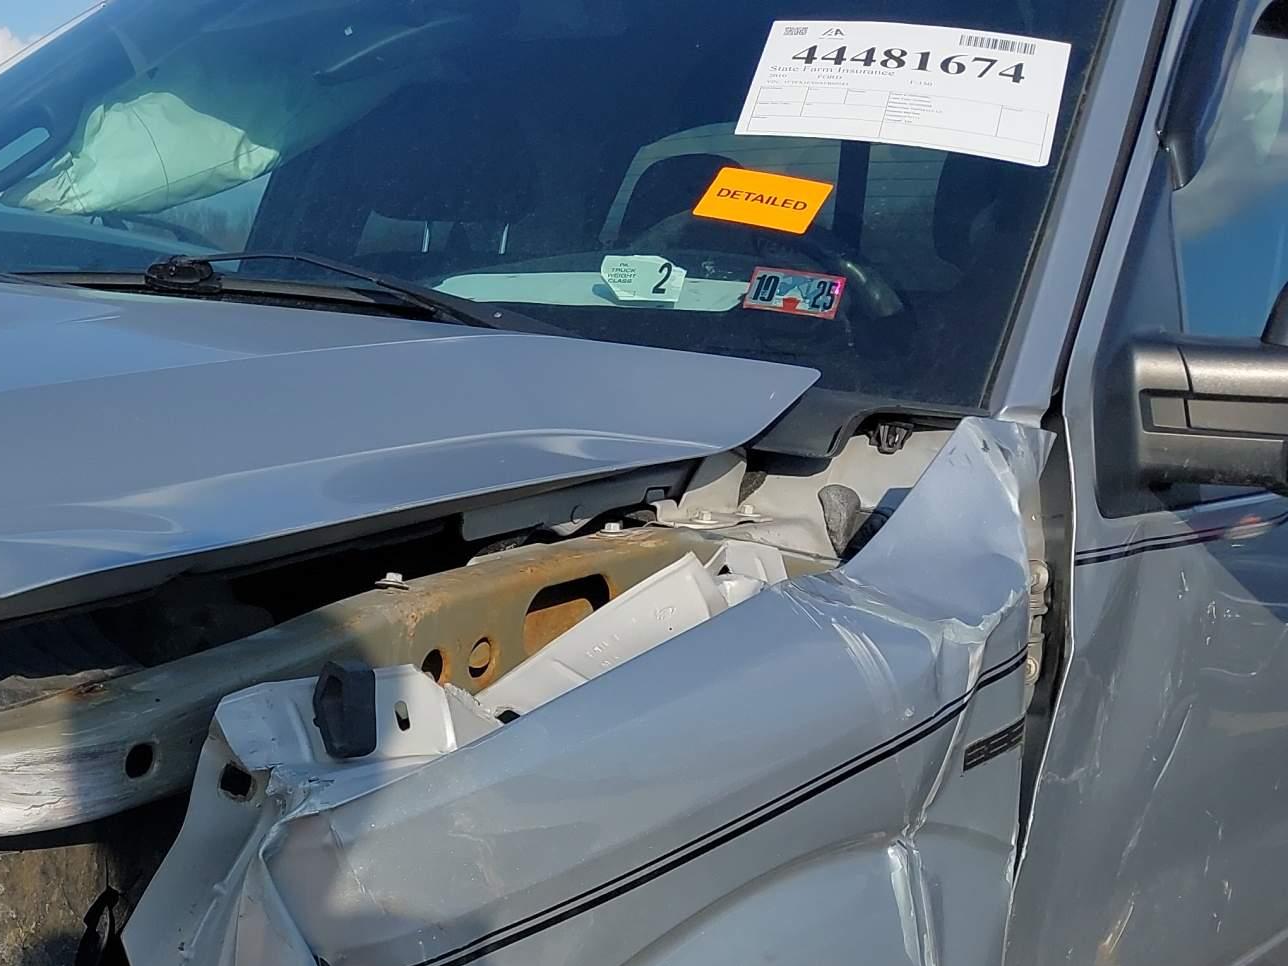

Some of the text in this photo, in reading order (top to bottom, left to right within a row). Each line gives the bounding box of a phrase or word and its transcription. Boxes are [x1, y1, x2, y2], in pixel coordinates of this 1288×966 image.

[792, 45, 1025, 84] 44481674
[802, 65, 833, 73] Farm
[838, 66, 895, 76] Insurance
[716, 187, 807, 211] DETAILED
[652, 262, 673, 294] 2
[811, 281, 841, 310] 25
